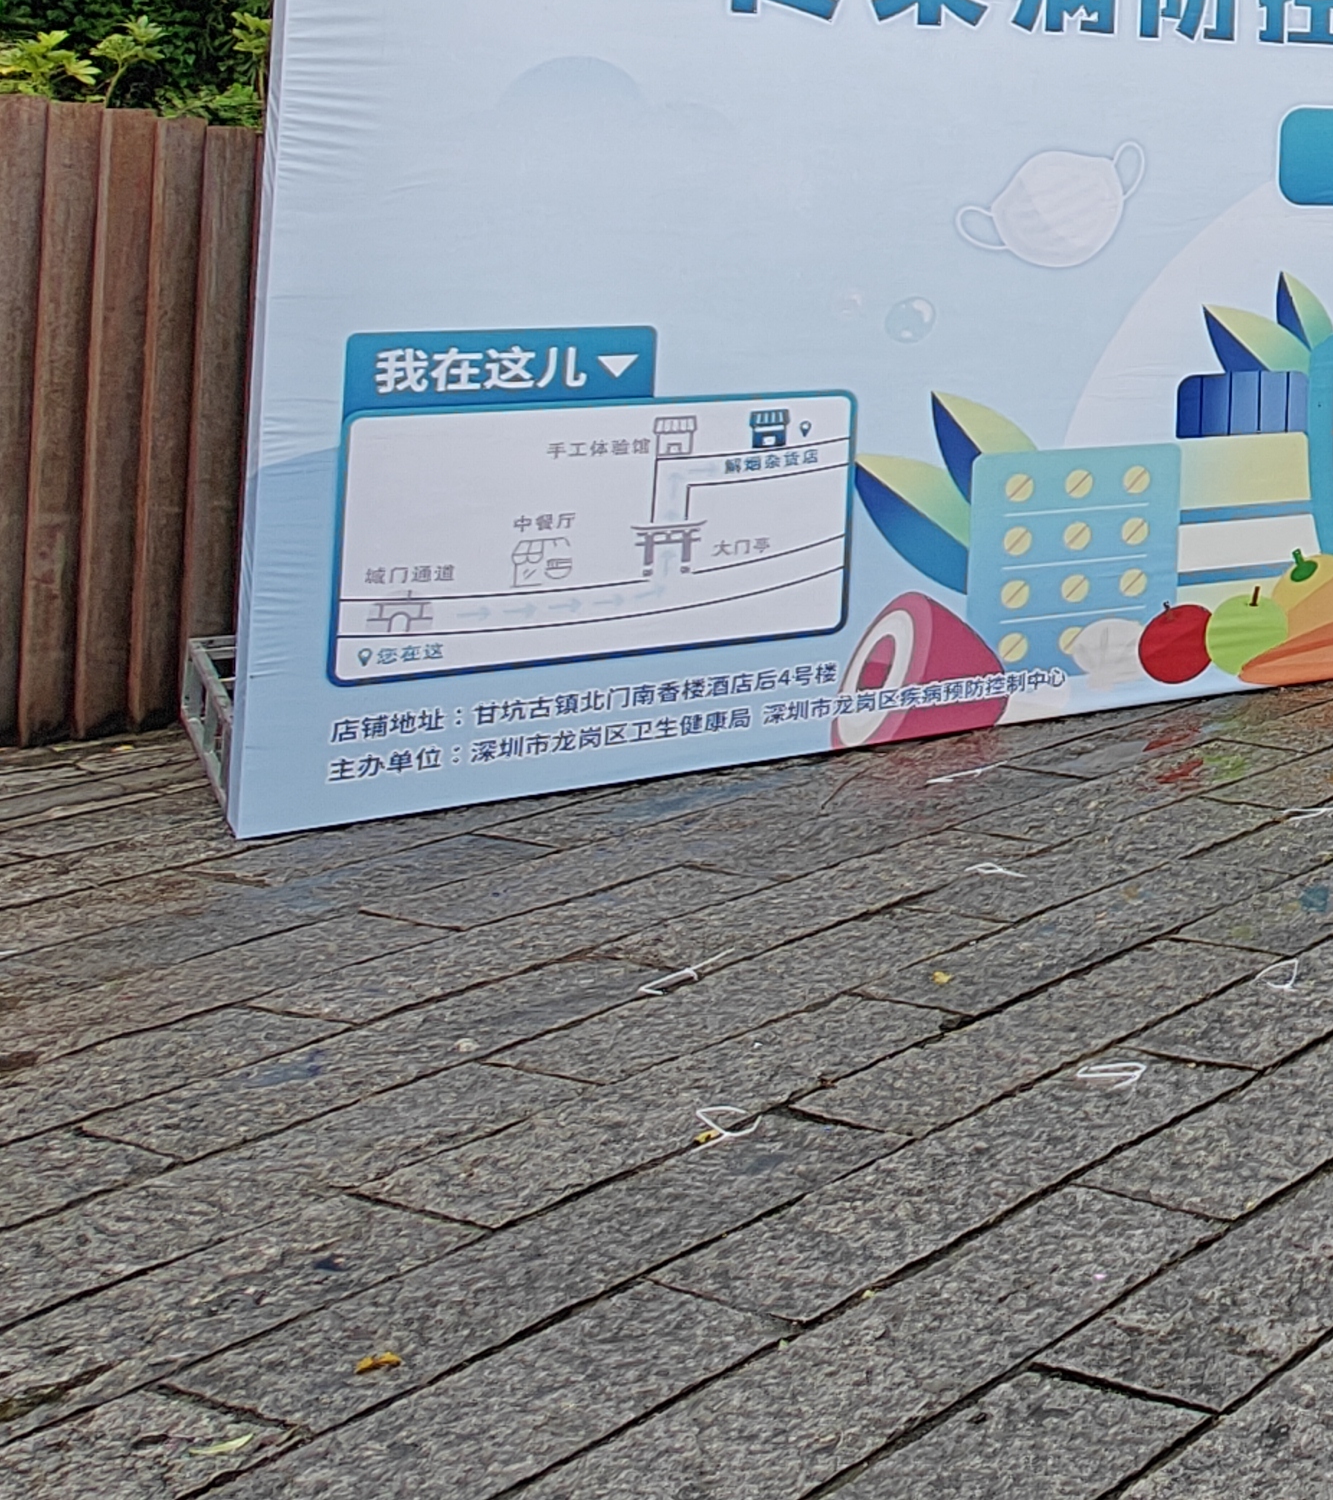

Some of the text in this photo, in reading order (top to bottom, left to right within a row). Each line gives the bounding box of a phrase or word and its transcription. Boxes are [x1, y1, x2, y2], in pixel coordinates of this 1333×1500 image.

[374, 346, 588, 395] 我在这儿
[513, 512, 576, 533] 中餐厅
[365, 564, 455, 585] 城门通道
[376, 642, 444, 665] 您在这
